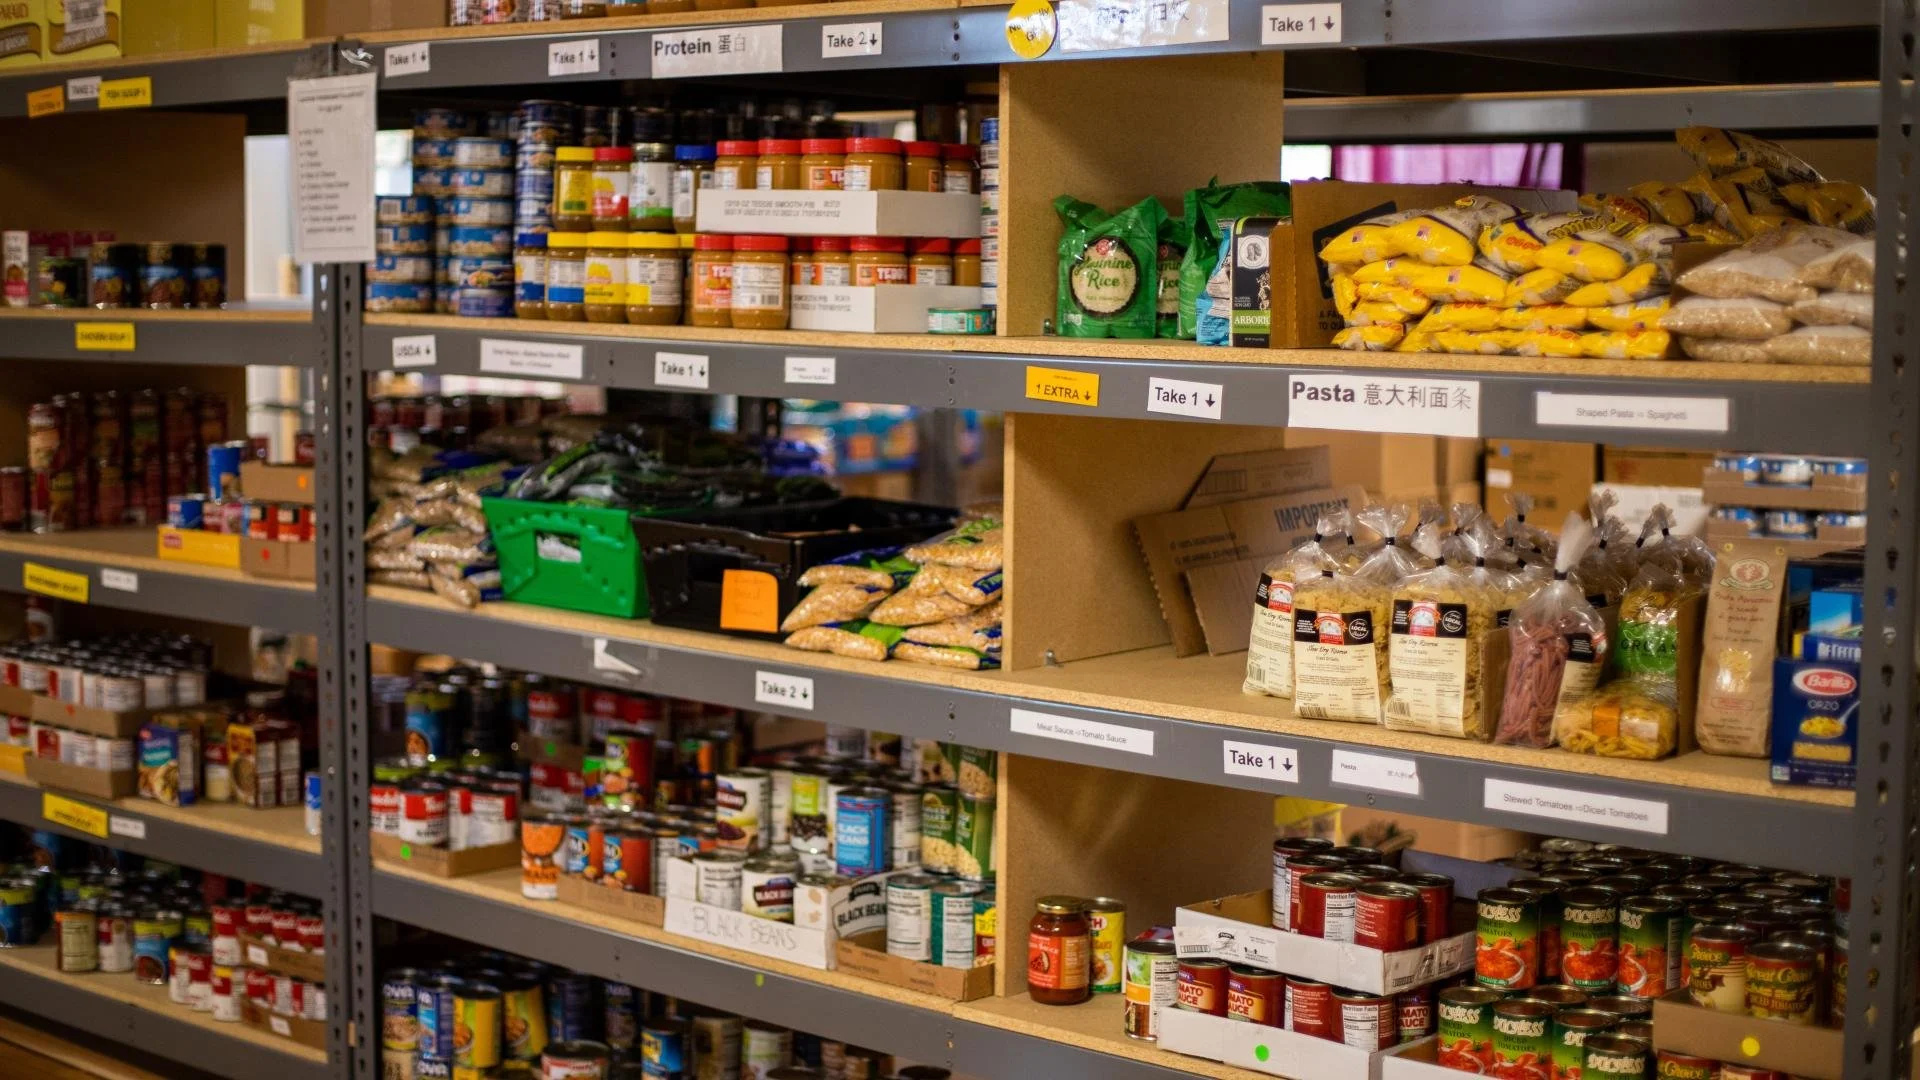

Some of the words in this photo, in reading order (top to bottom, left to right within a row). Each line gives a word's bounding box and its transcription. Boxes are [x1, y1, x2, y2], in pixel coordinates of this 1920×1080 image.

[1269, 16, 1303, 32] Take
[1308, 16, 1316, 31] 1
[654, 37, 711, 57] Protein
[718, 33, 745, 54] 蛋白
[827, 34, 854, 48] Take
[389, 52, 408, 67] Take
[412, 51, 417, 63] 1
[554, 52, 575, 64] Take
[578, 50, 584, 63] 1
[1086, 269, 1121, 290] Rice
[396, 344, 420, 356] USDA
[662, 362, 684, 376] Take
[688, 366, 693, 377] 1
[1036, 384, 1041, 394] 1
[1044, 384, 1080, 400] EXTRA
[1155, 387, 1186, 404] Take
[1192, 392, 1198, 406] 1
[1292, 381, 1356, 402] Pasta
[1363, 382, 1472, 410] 意大利面条
[1576, 407, 1608, 418] Shaped
[1610, 408, 1634, 418] Pasta
[1646, 410, 1688, 421] Spaghetti
[1445, 616, 1461, 626] LOCAL
[761, 680, 786, 696] Take
[790, 686, 796, 698] 2
[1807, 673, 1851, 690] Barilla
[1808, 699, 1839, 712] ORZO
[1036, 722, 1052, 732] Meat
[1054, 725, 1074, 736] Sauce
[1081, 730, 1104, 742] Tomato
[1106, 734, 1127, 744] Sauce
[1229, 750, 1263, 768] Take
[1268, 756, 1274, 770] 1
[1340, 763, 1357, 771] Pasta
[1504, 793, 1533, 805] Stewed
[1536, 798, 1573, 811] Tomatoes
[1583, 804, 1606, 816] Diced
[1609, 808, 1648, 821] Tomatoes
[838, 906, 863, 927] BLACK
[750, 918, 796, 950] BEANS
